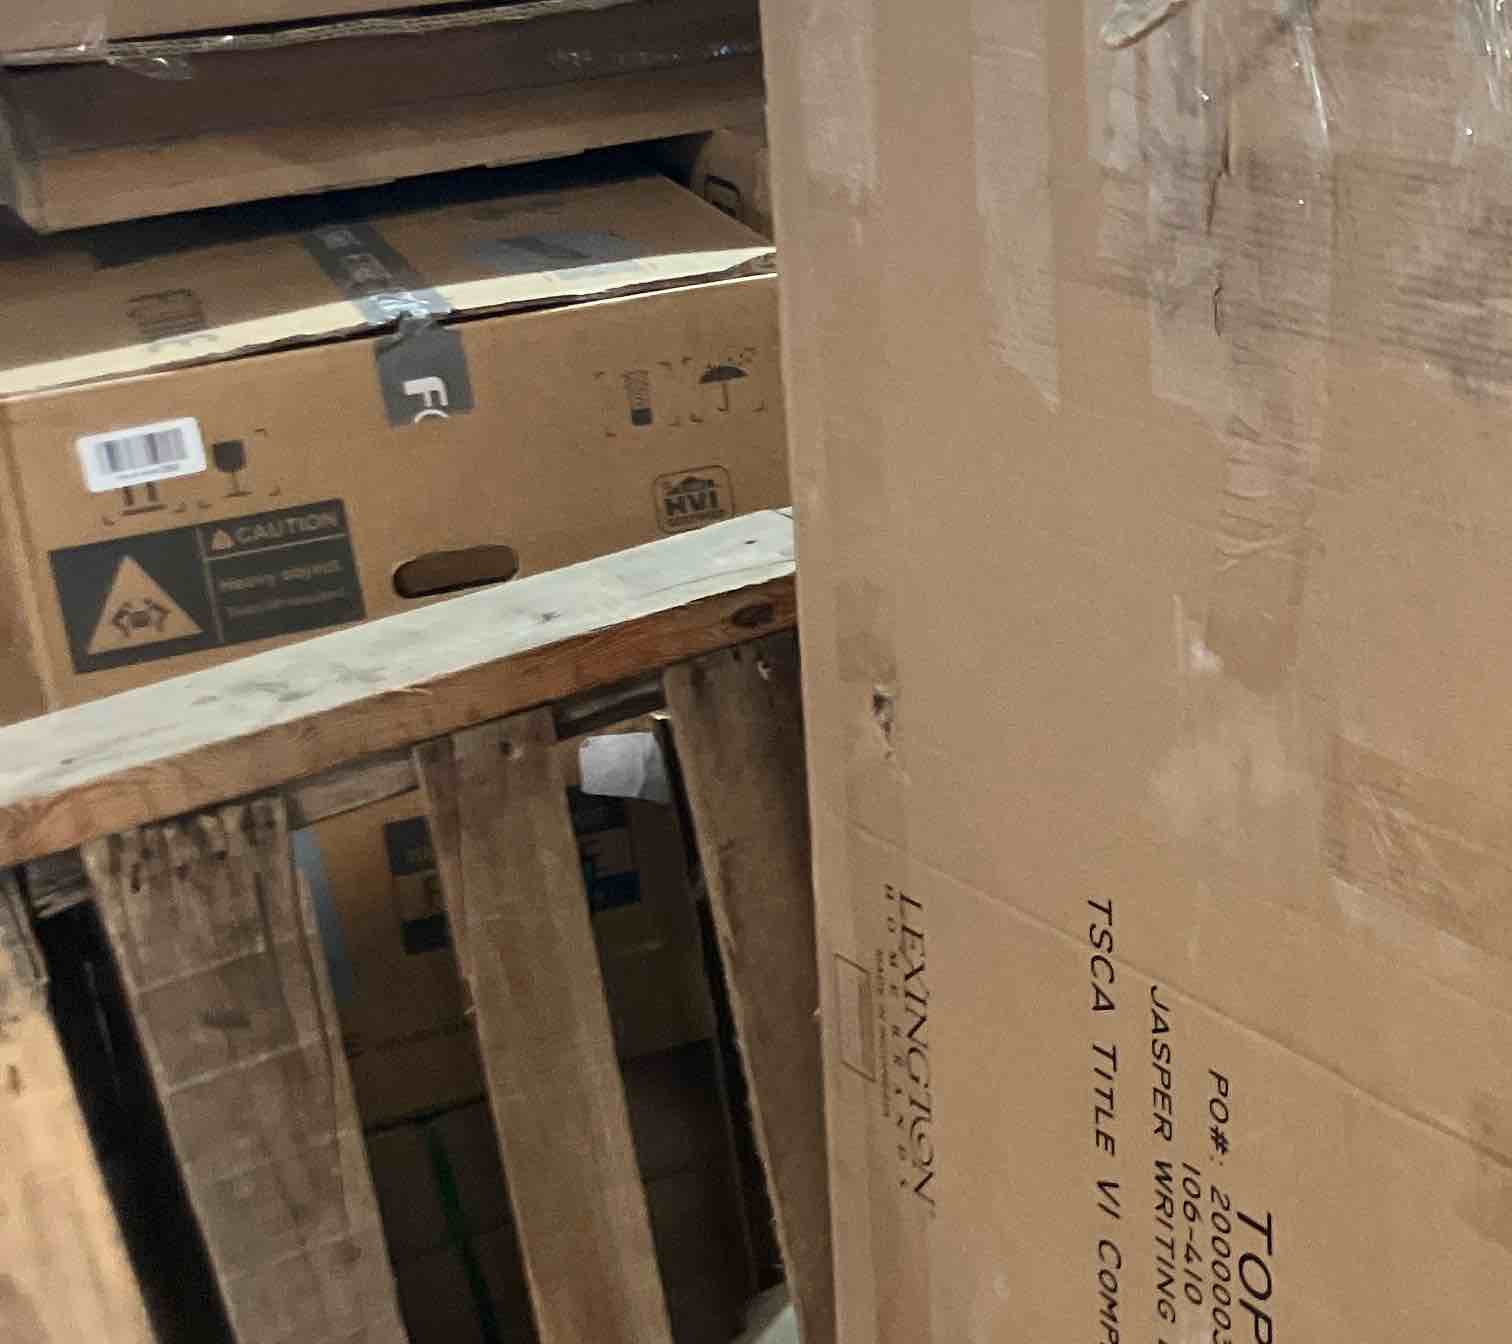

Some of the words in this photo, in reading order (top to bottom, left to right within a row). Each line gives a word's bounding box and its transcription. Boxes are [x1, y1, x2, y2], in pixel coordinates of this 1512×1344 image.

[234, 511, 341, 543] CAUTION
[1088, 895, 1116, 1013] TSCA
[898, 892, 935, 1205] LEXINGTON
[1091, 1040, 1118, 1158] TITLE
[1149, 984, 1174, 1143] JASPER
[1208, 1068, 1231, 1167] PO#:
[1095, 1177, 1121, 1220] VI
[1154, 1158, 1177, 1325] WRITING
[1180, 1160, 1203, 1306] 106-410
